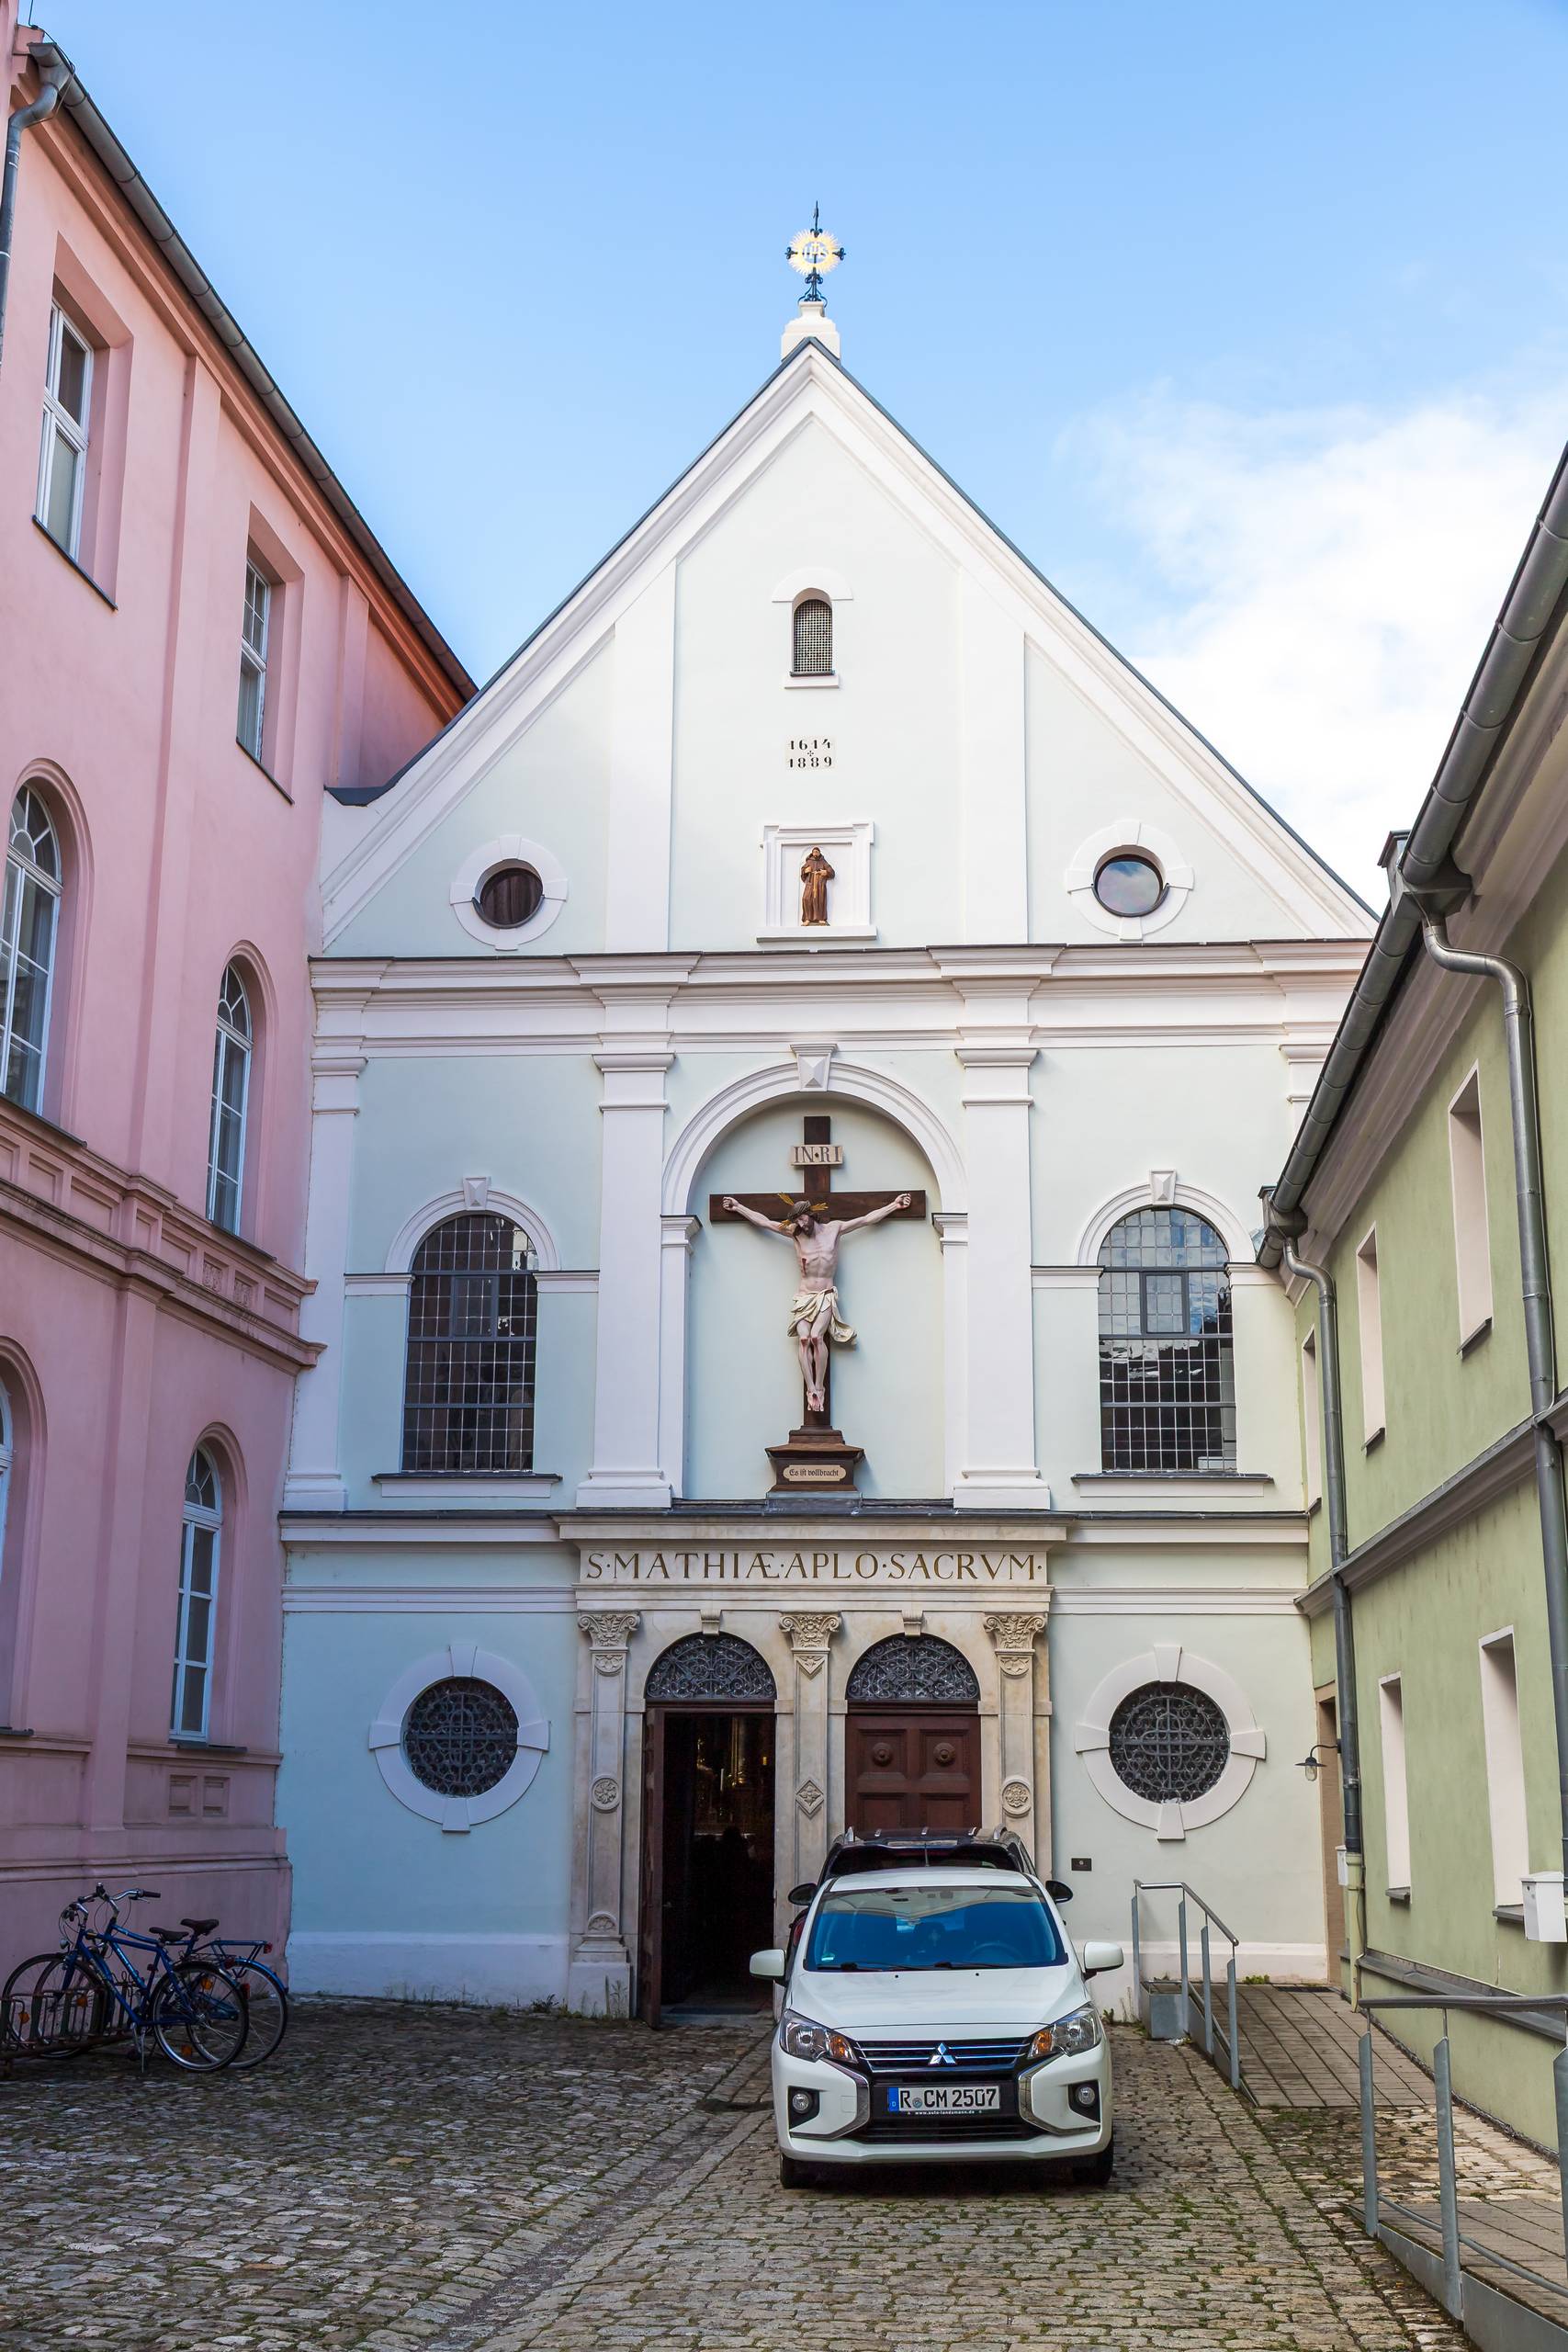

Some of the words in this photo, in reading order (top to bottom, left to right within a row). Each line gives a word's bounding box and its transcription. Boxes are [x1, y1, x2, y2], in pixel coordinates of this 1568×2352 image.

[790, 739, 830, 750] 1614
[789, 756, 832, 768] 1889
[899, 2090, 911, 2109] R
[923, 2089, 948, 2108] CM
[952, 2088, 997, 2108] 2507
